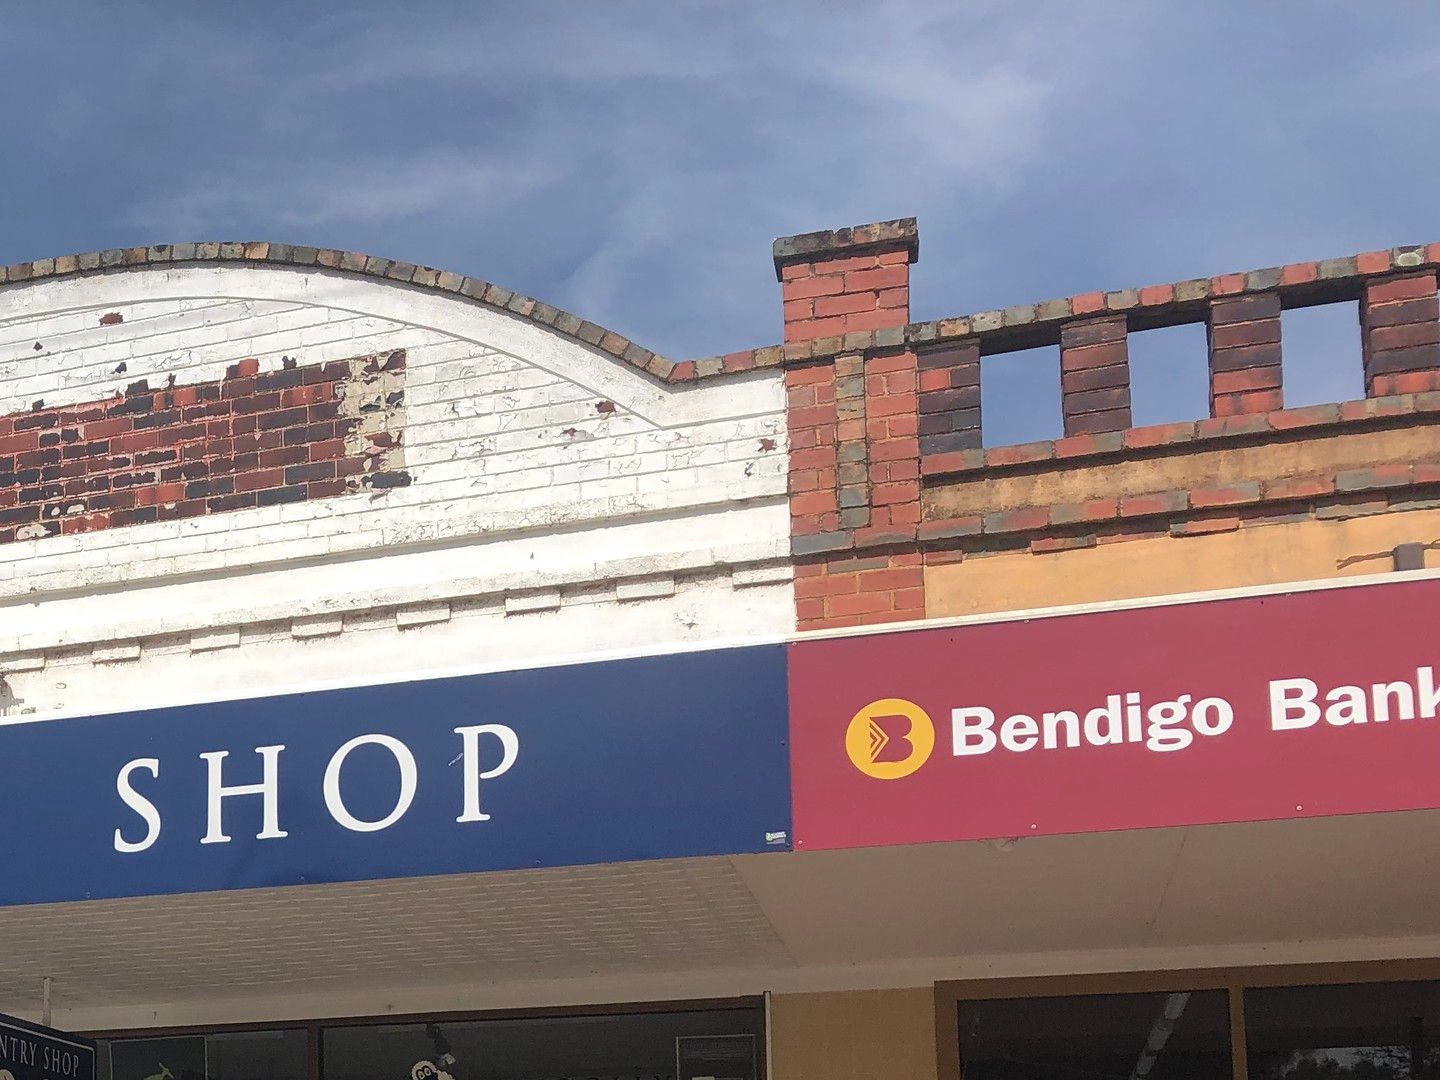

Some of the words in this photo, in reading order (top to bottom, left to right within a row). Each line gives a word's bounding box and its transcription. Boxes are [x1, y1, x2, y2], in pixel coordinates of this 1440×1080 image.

[951, 691, 1234, 753] Bendigo
[1268, 666, 1440, 732] Bank
[114, 723, 519, 854] SHOP
[44, 1046, 79, 1078] SHOP
